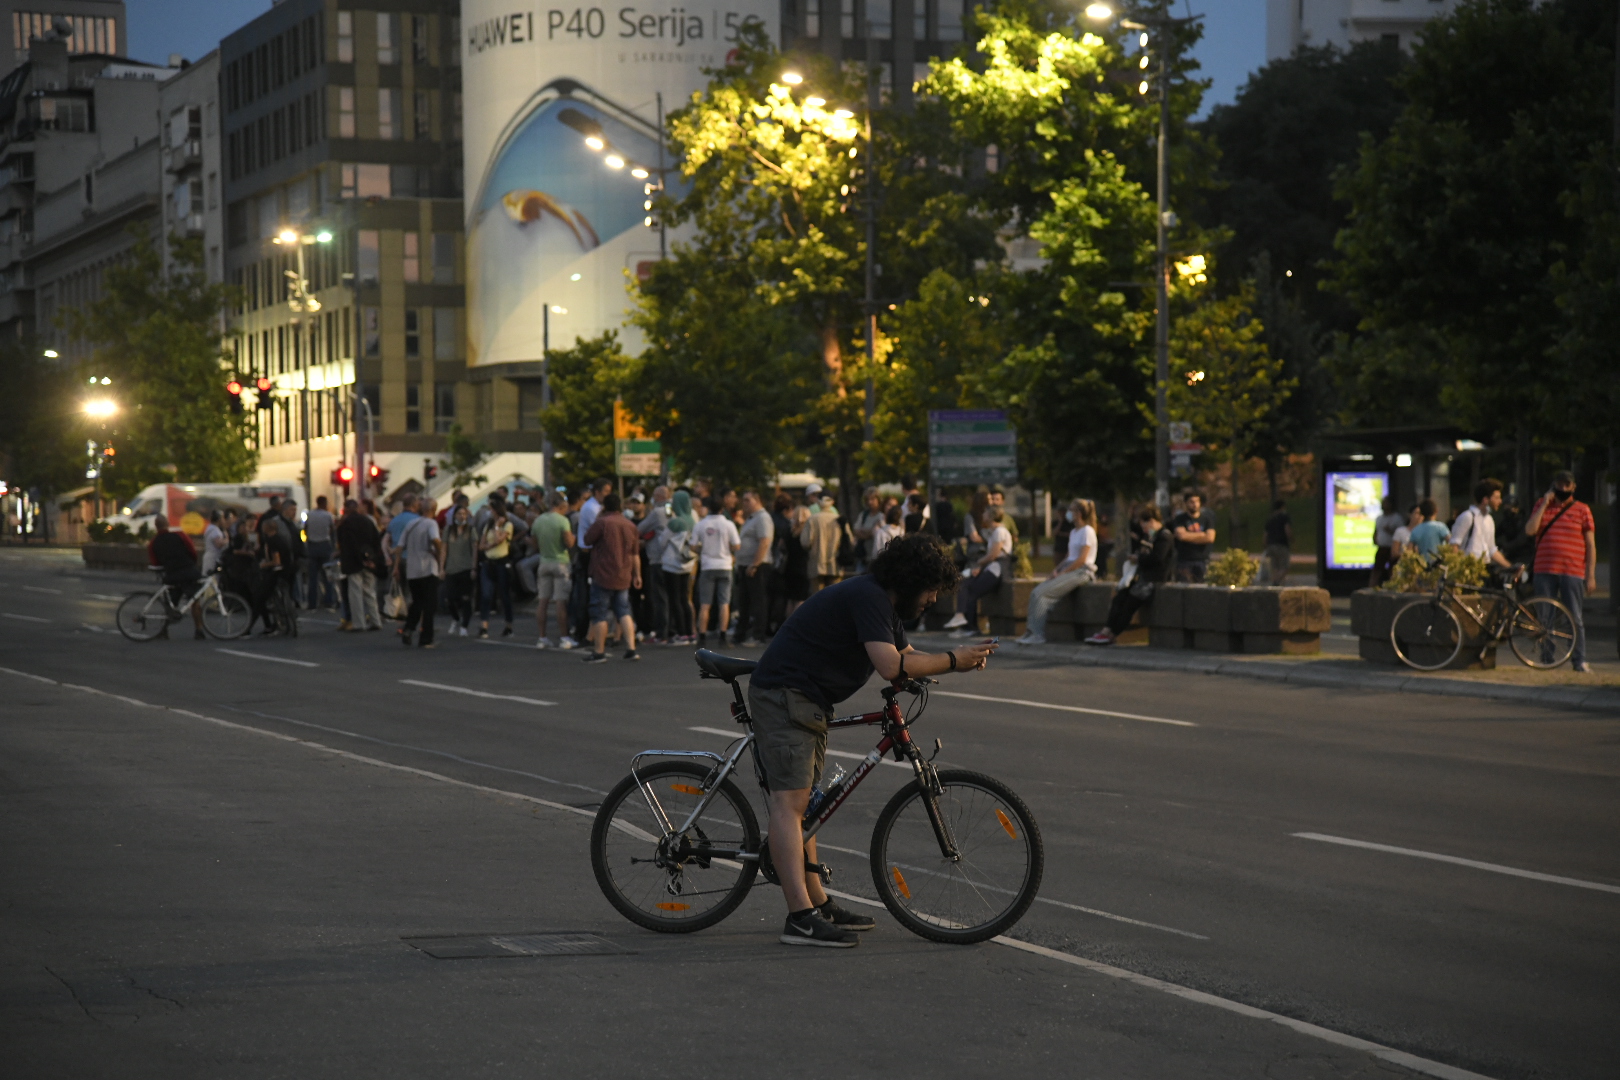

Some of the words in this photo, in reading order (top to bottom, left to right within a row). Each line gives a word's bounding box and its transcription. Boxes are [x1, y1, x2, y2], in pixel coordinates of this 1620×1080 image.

[467, 11, 533, 56] HUAWEI
[548, 7, 605, 39] P40
[618, 7, 704, 47] Serija
